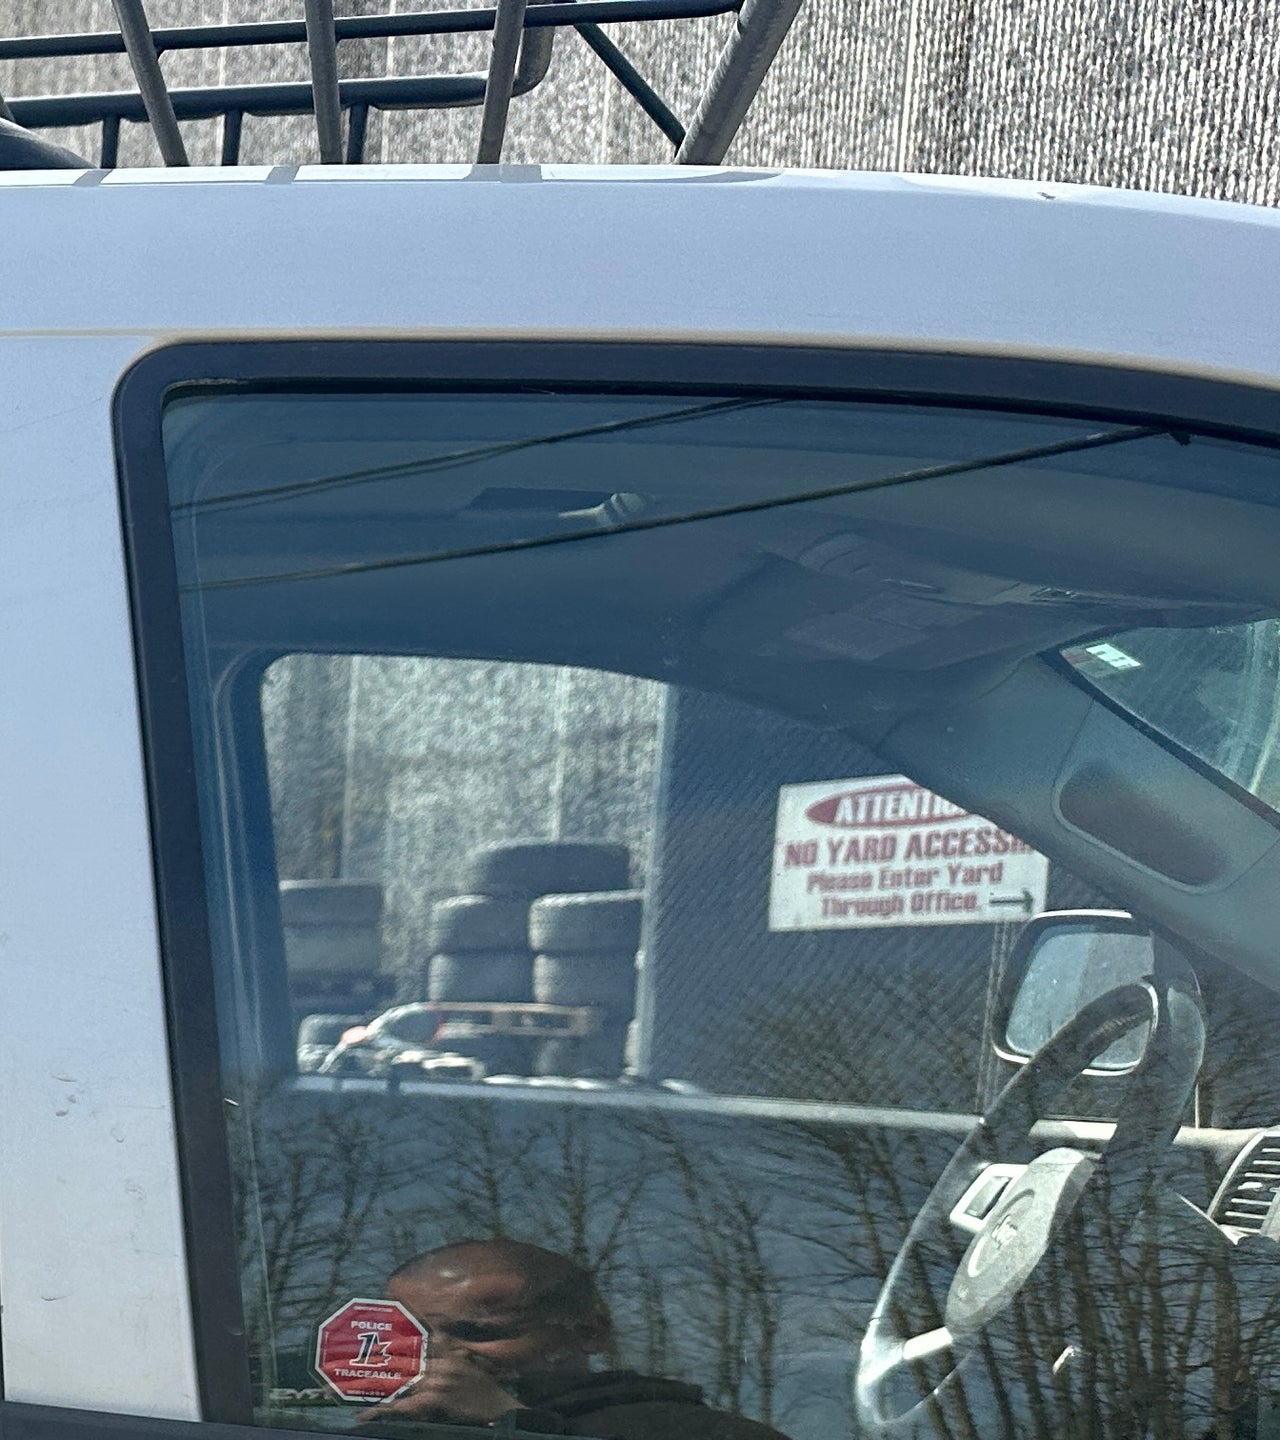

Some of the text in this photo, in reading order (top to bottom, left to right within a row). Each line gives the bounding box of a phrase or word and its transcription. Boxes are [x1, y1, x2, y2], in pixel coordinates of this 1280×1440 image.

[834, 788, 969, 825] ATTENTI
[785, 841, 818, 867] NO
[827, 834, 897, 865] YARD
[806, 860, 1004, 894] Please Enter Yard
[821, 896, 904, 917] Through
[350, 1320, 392, 1331] POLICE
[334, 1368, 402, 1380] TRACEABLE
